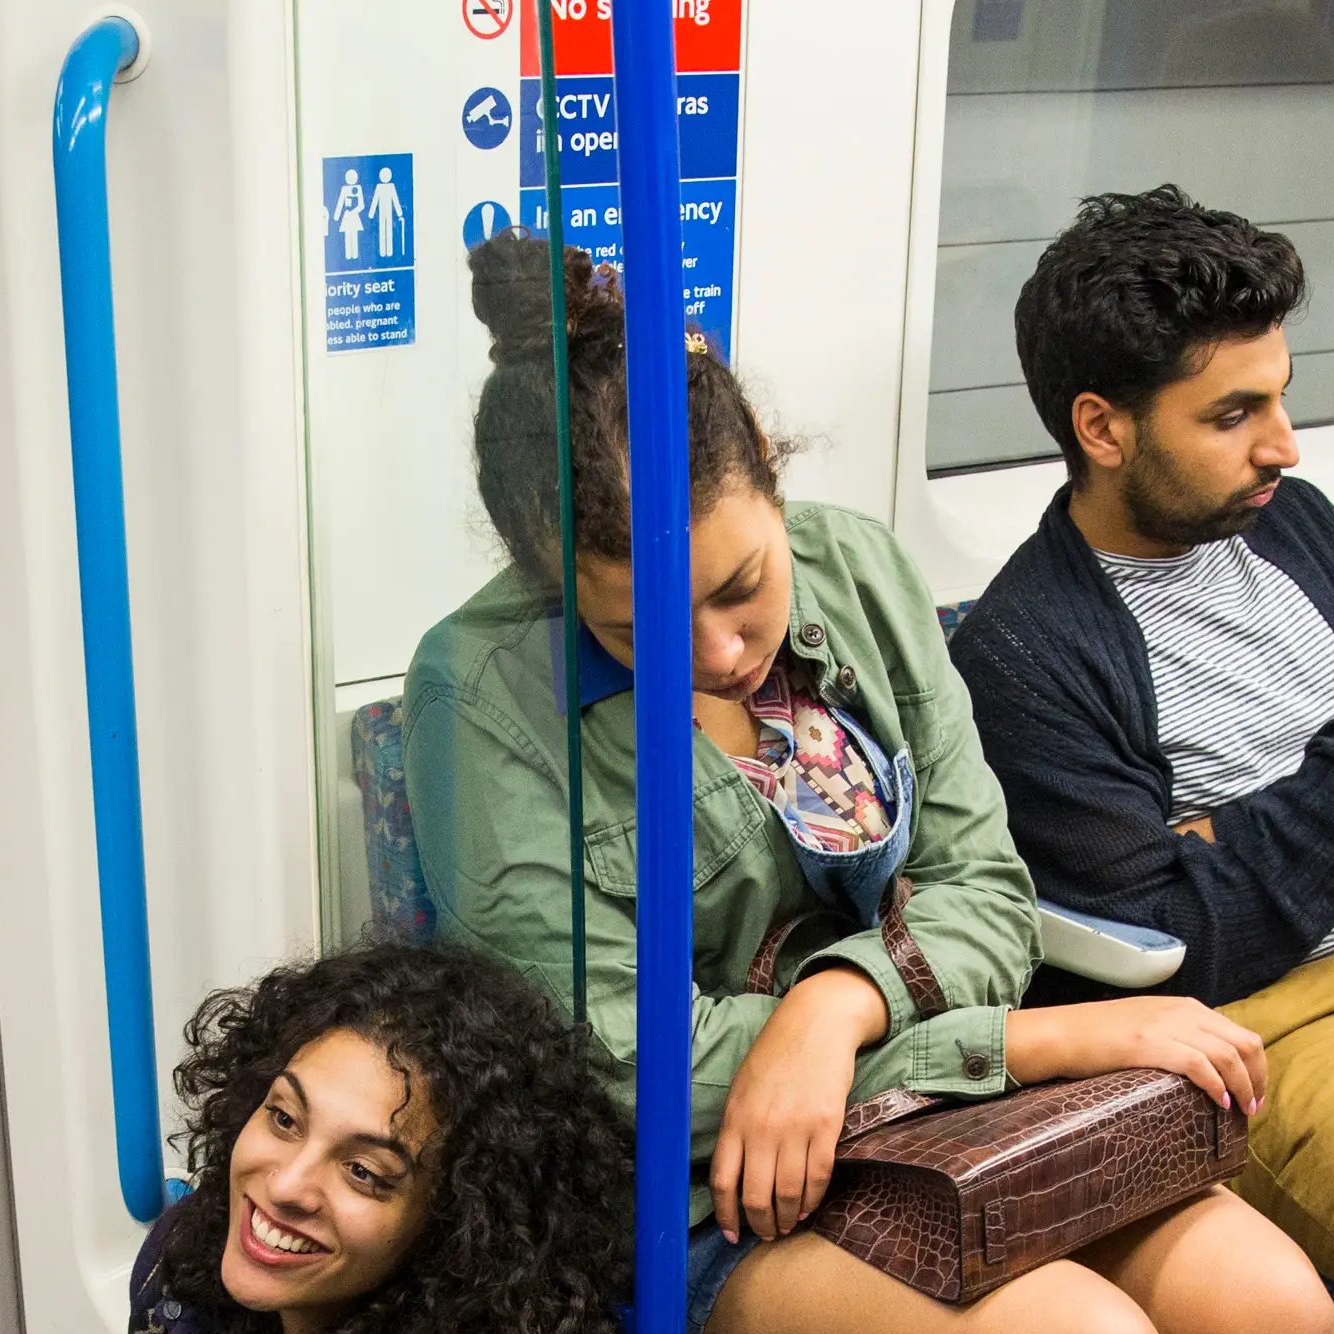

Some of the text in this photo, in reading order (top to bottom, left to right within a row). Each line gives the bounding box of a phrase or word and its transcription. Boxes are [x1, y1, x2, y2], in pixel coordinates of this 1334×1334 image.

[570, 207, 597, 228] an
[595, 243, 616, 258] red
[326, 279, 395, 299] ority seat
[694, 284, 722, 298] train
[327, 301, 401, 318] people who are
[685, 300, 706, 315] off
[355, 315, 399, 330] pregnant
[327, 328, 408, 345] ess able to stand
